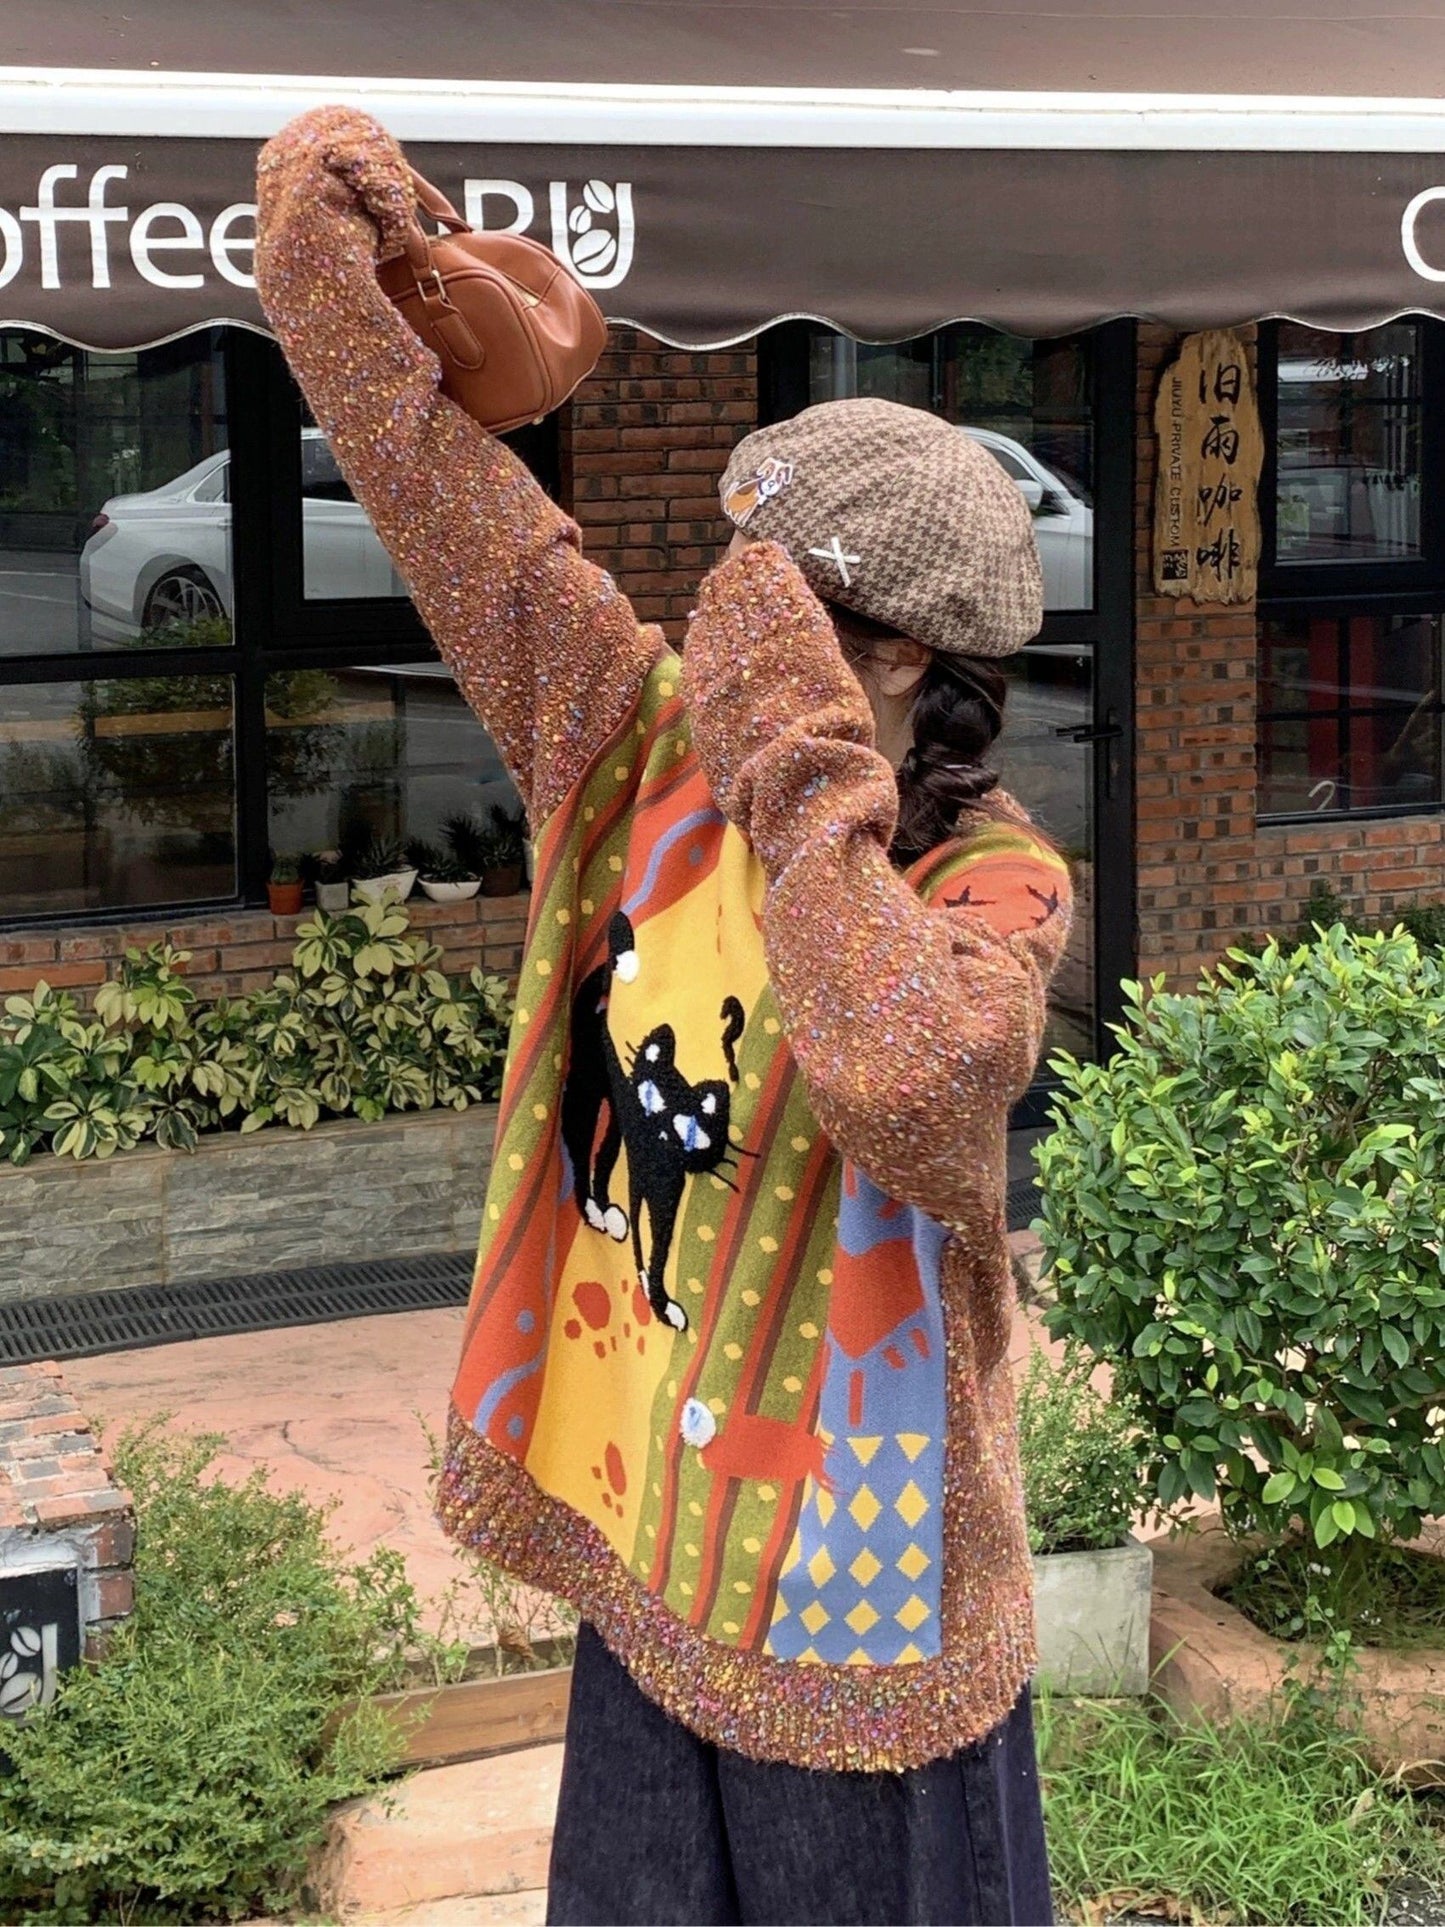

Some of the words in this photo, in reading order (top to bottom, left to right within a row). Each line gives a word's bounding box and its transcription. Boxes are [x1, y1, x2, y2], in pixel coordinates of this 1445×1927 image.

[1171, 376, 1182, 418] JIUYU
[1170, 423, 1181, 480] PRIVATE
[1197, 363, 1242, 581] 旧雨咖啡
[1170, 487, 1181, 546] CUSTOM
